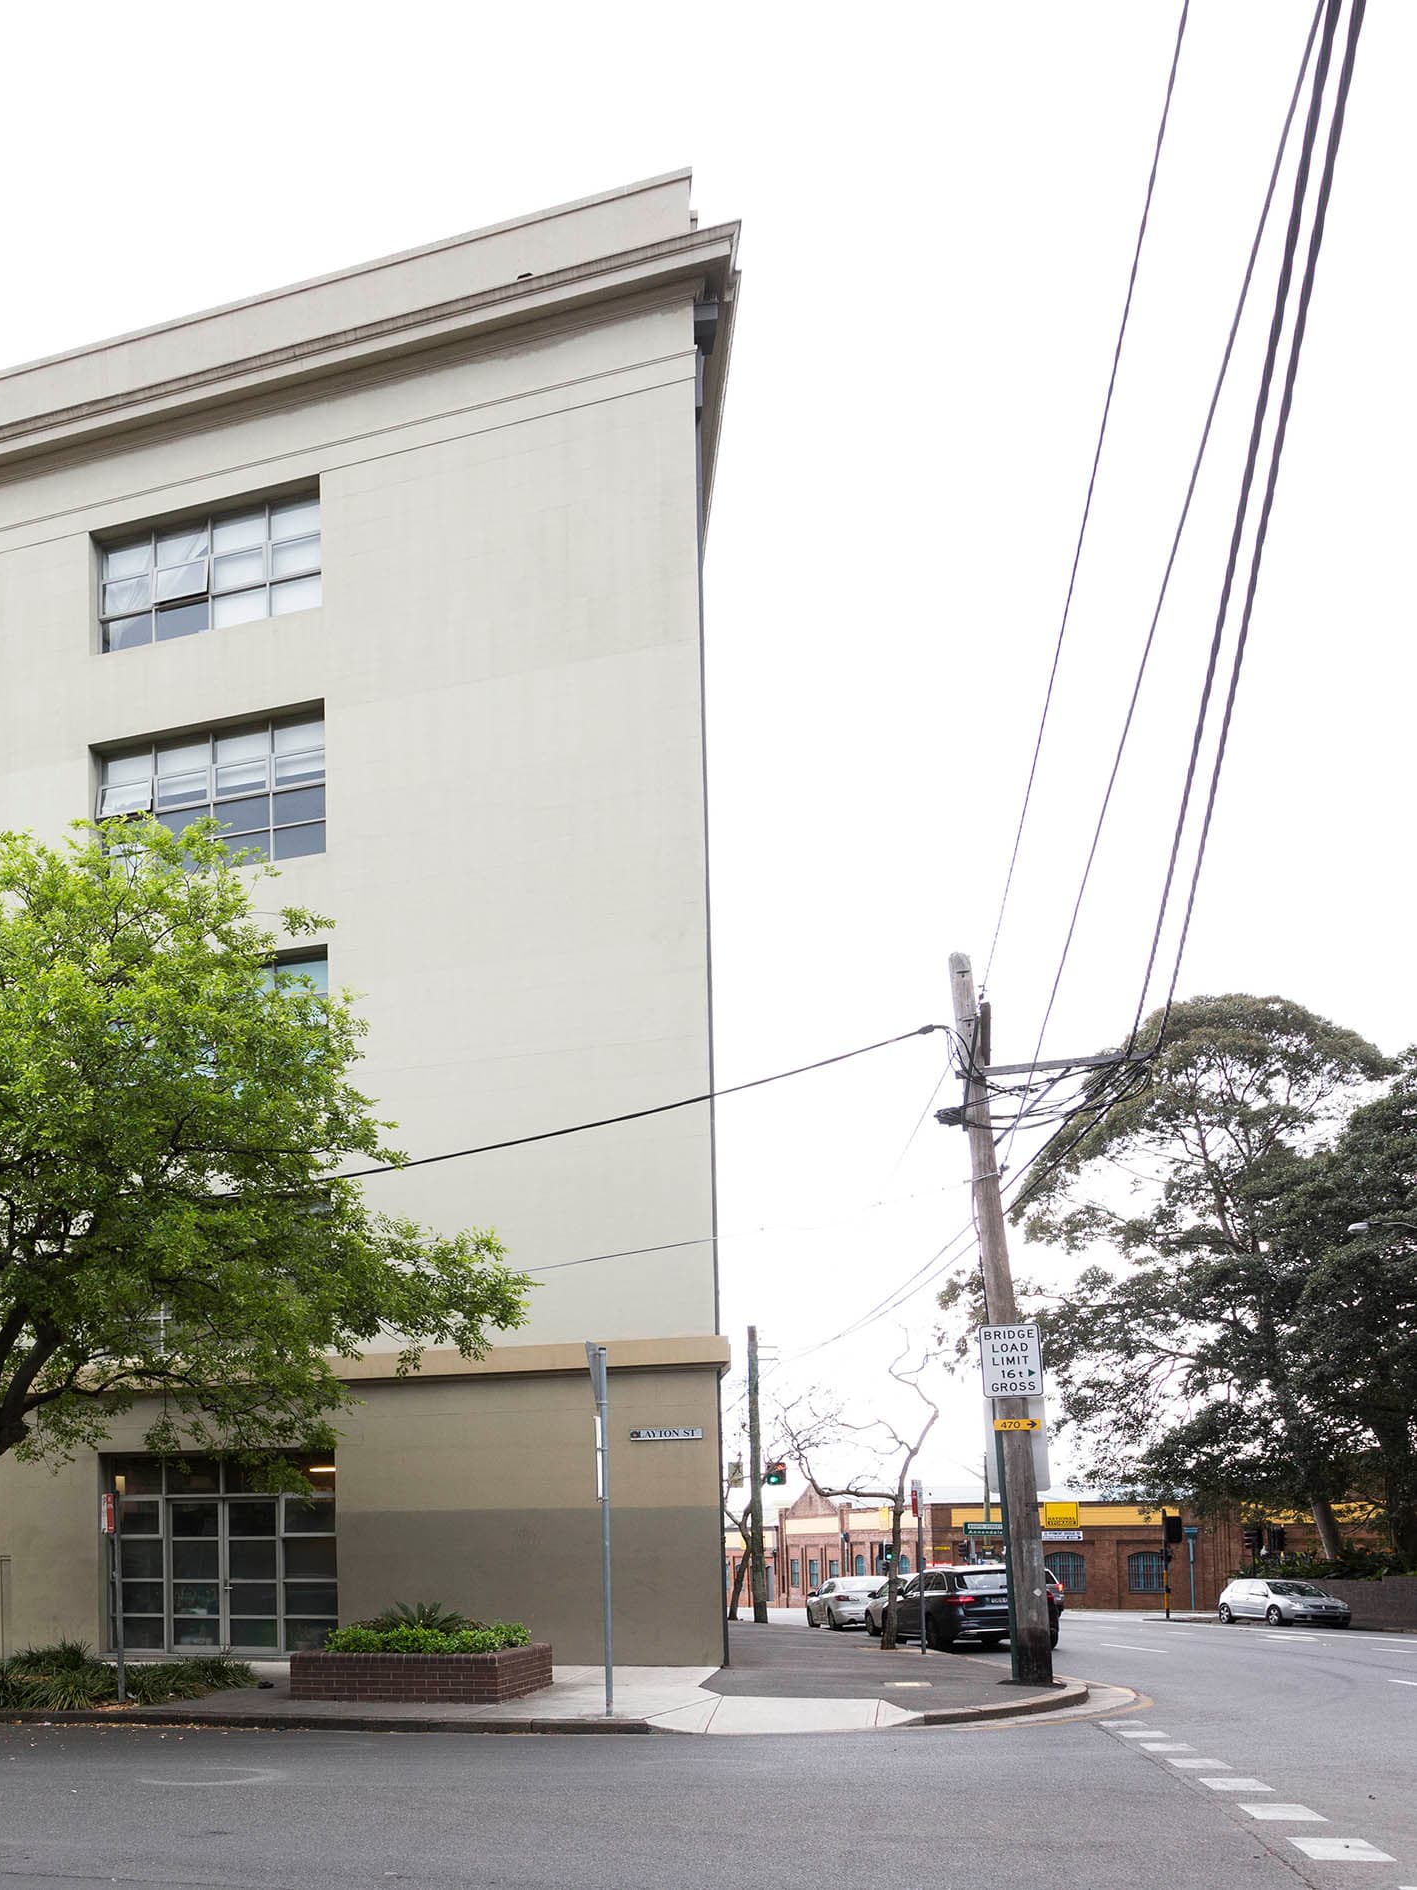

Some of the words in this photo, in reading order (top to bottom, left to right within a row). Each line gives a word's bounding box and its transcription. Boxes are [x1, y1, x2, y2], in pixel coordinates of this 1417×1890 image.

[984, 1329, 1035, 1341] BRIDGE
[992, 1342, 1029, 1353] LOAD
[992, 1355, 1030, 1367] LIMIT
[1001, 1369, 1016, 1379] 16
[991, 1381, 1036, 1393] GROSS
[1000, 1421, 1021, 1429] 470
[683, 1429, 695, 1438] ST
